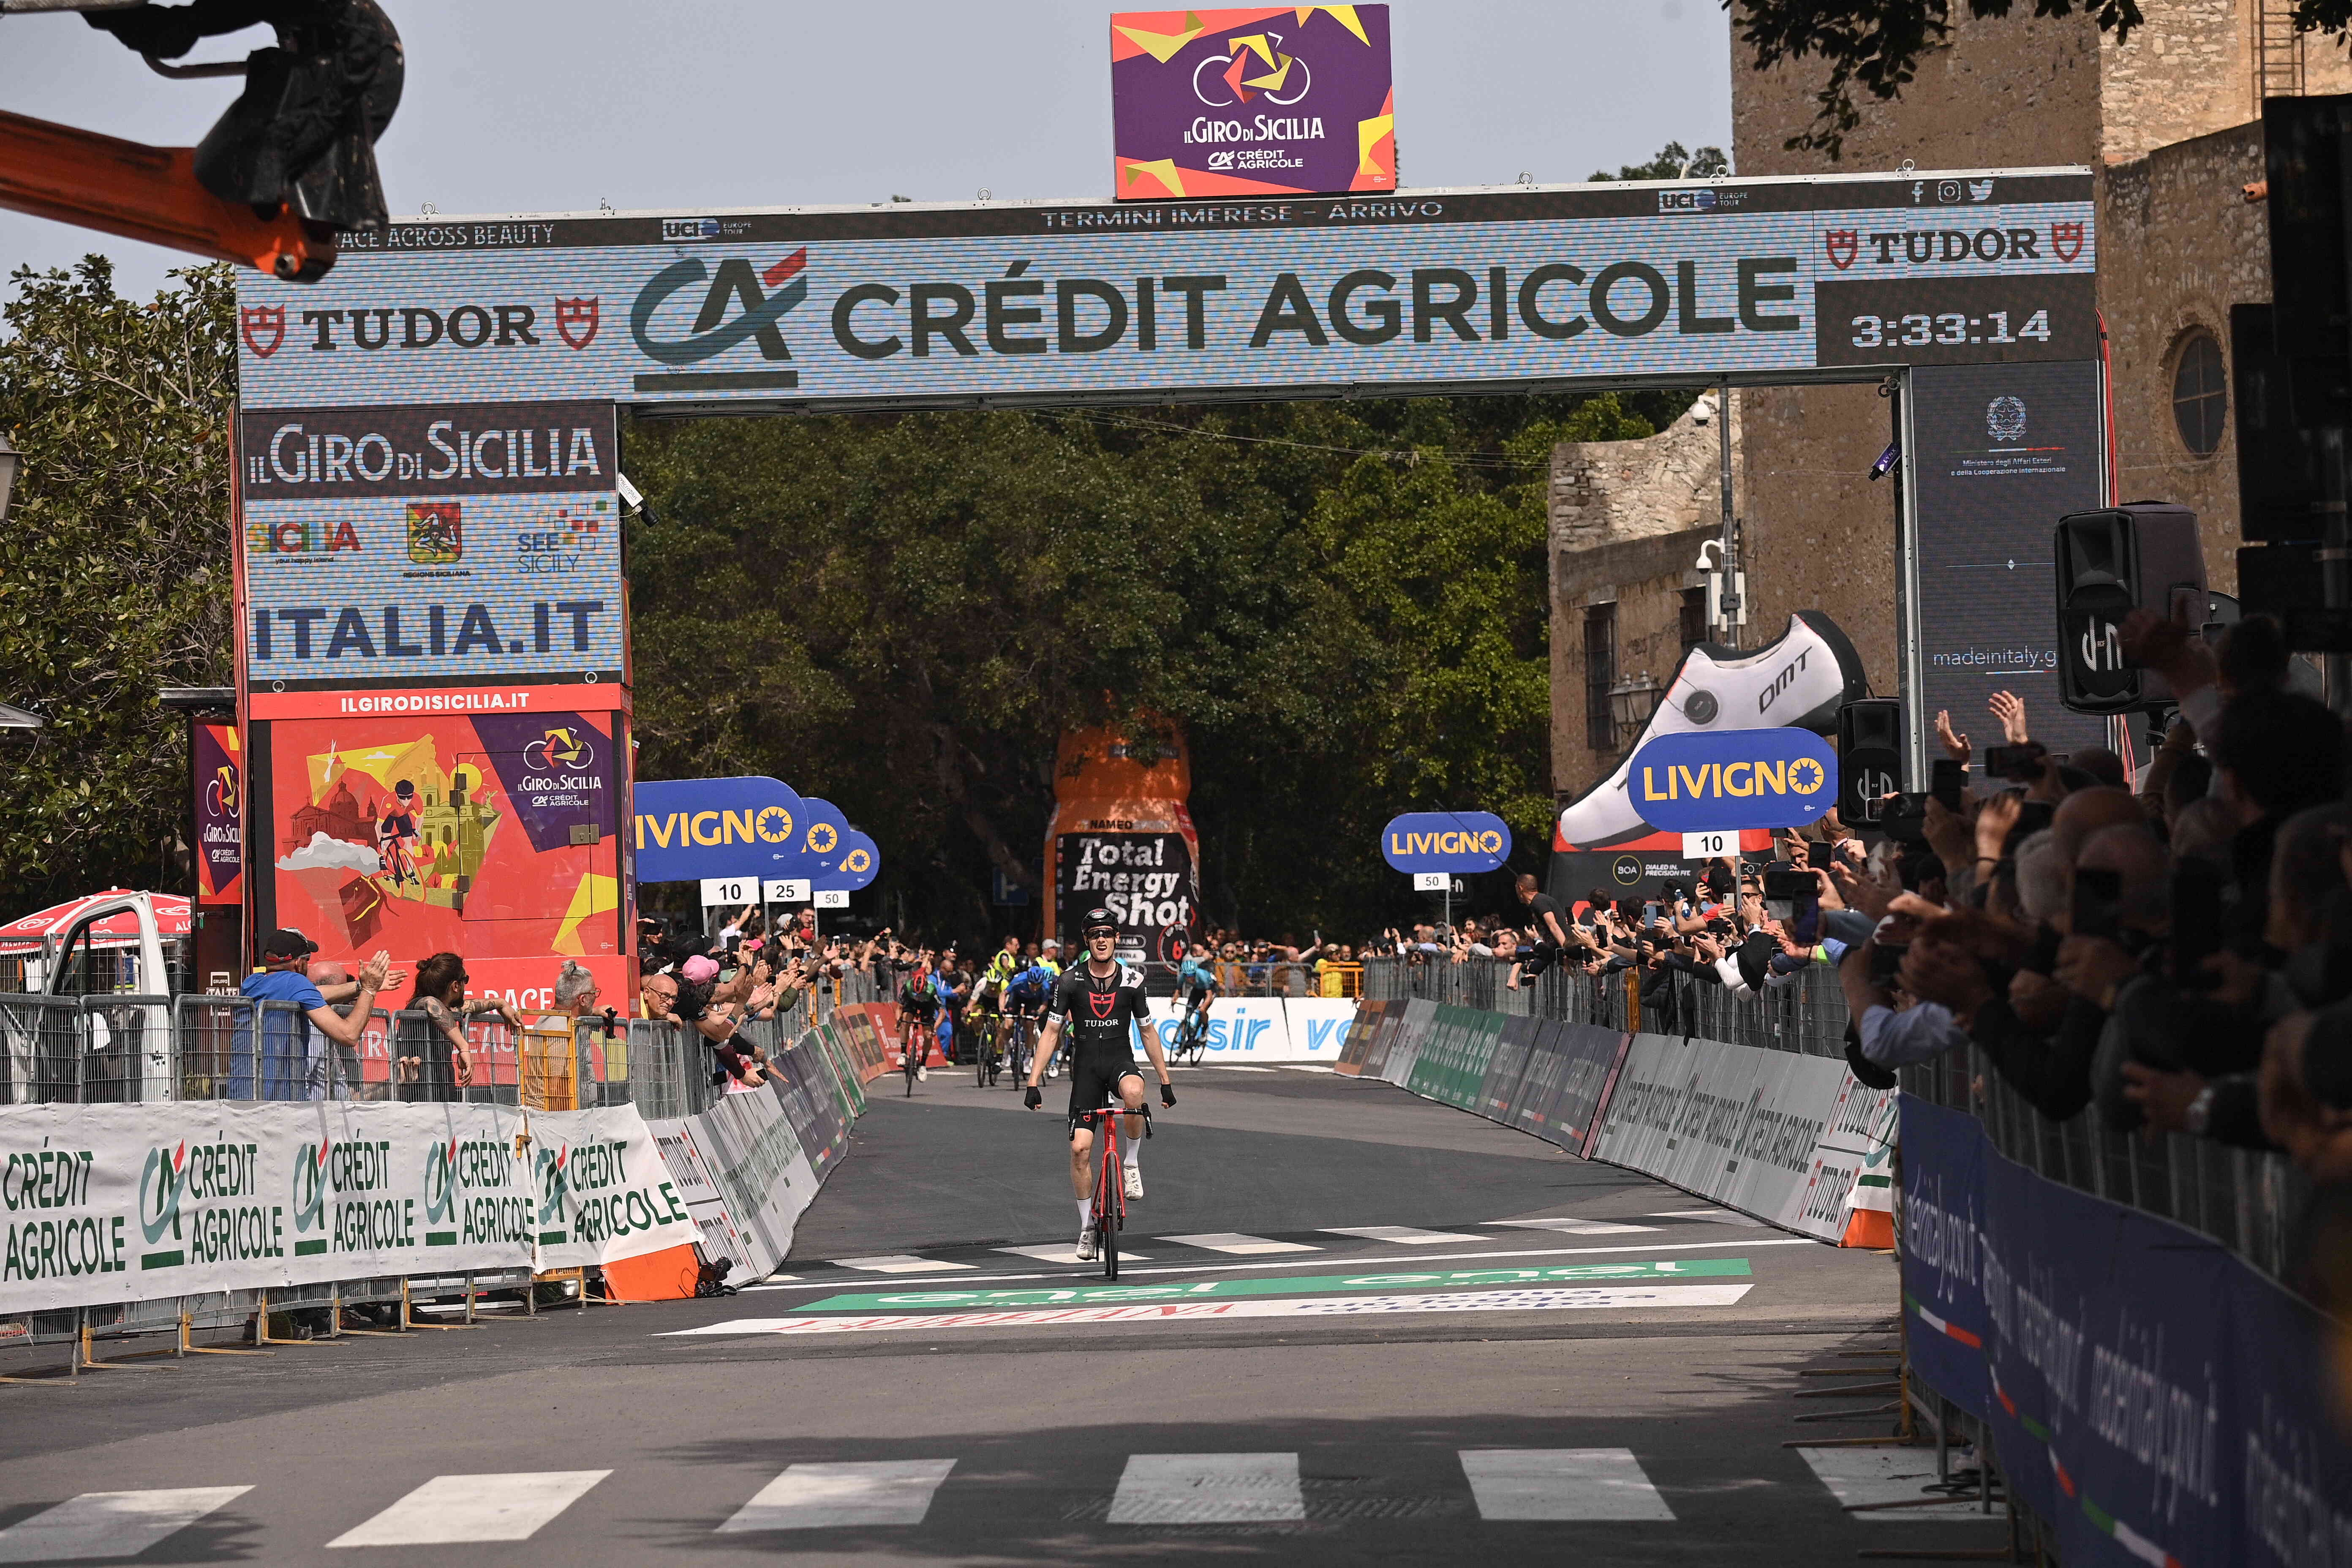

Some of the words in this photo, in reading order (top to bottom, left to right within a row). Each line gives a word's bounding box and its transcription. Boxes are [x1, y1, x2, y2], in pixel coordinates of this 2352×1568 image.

[1184, 131, 1193, 144] IL
[1192, 117, 1241, 143] GIRO
[1243, 128, 1253, 142] DI
[1255, 114, 1325, 141] SICILIA
[1237, 148, 1285, 160] CRÉDIT
[1237, 158, 1304, 169] AGRICOLE
[1662, 193, 1694, 208] UCI
[666, 222, 698, 237] UCI
[723, 220, 752, 229] EUROPE
[1040, 209, 1162, 229] TERMINI
[1171, 206, 1294, 225] IMERESE
[1328, 201, 1444, 220] ARRIVO
[387, 226, 468, 248] ACROSS
[474, 224, 555, 245] BEAUTY
[1870, 228, 2041, 264] TUDOR
[832, 261, 1227, 359] CRÉDIT
[1249, 257, 1800, 347] AGRICOLE
[303, 305, 540, 351] TUDOR
[1852, 310, 2051, 347] 3:33:14
[249, 456, 271, 485] IL
[270, 423, 394, 484] GIRO
[398, 453, 423, 481] DI
[427, 420, 601, 480] SICILIA
[1883, 448, 1896, 463] LYNX
[248, 523, 362, 552] SICILIA
[518, 533, 560, 553] SEE
[518, 554, 579, 574] SICILY
[255, 602, 604, 659] ITALIA.IT
[1933, 645, 2057, 669] madeinitaly.g
[1759, 645, 1812, 715] DMT
[341, 693, 529, 712] ILGIRODISICILIA.IT
[523, 776, 552, 791] GIRO
[560, 774, 602, 790] SICILIA
[1643, 757, 1824, 801] LIVIGNO
[204, 833, 207, 842] IL
[206, 823, 223, 842] GIRO
[223, 833, 226, 842] DI
[226, 824, 241, 843] SICILI
[635, 806, 793, 849] IVIGNO
[1080, 838, 1164, 866] Total
[1392, 830, 1503, 855] LIVIGNO
[1701, 836, 1723, 852] 10
[1073, 865, 1180, 899] Energy
[1426, 877, 1439, 886] 50
[1618, 866, 1637, 874] BOA
[719, 884, 741, 900] 10
[776, 885, 795, 898] 25
[825, 894, 838, 904] 50
[1105, 892, 1189, 926] Shot
[1048, 1013, 1060, 1022] OSS
[1771, 1113, 1824, 1174] AGRICOLE
[189, 1130, 257, 1200] CRÉDIT
[331, 1128, 389, 1192] CRÉDIT
[459, 1130, 510, 1188] CRÉDIT
[571, 1134, 628, 1192] CRÉDIT
[3, 1136, 94, 1211] CRÉDIT
[1808, 1166, 1851, 1224] TUDOR
[333, 1199, 414, 1253] AGRICOLE
[463, 1197, 534, 1245] AGRICOLE
[573, 1181, 689, 1244] AGRICOLE
[4, 1216, 125, 1282] AGRICOLE
[191, 1206, 283, 1265] AGRICOLE
[1342, 1262, 1689, 1284] enel
[877, 1282, 1219, 1302] enel
[1419, 1295, 1656, 1304] leggera
[772, 1304, 1235, 1331] LAURETANA
[1322, 1301, 1612, 1312] d'Europa
